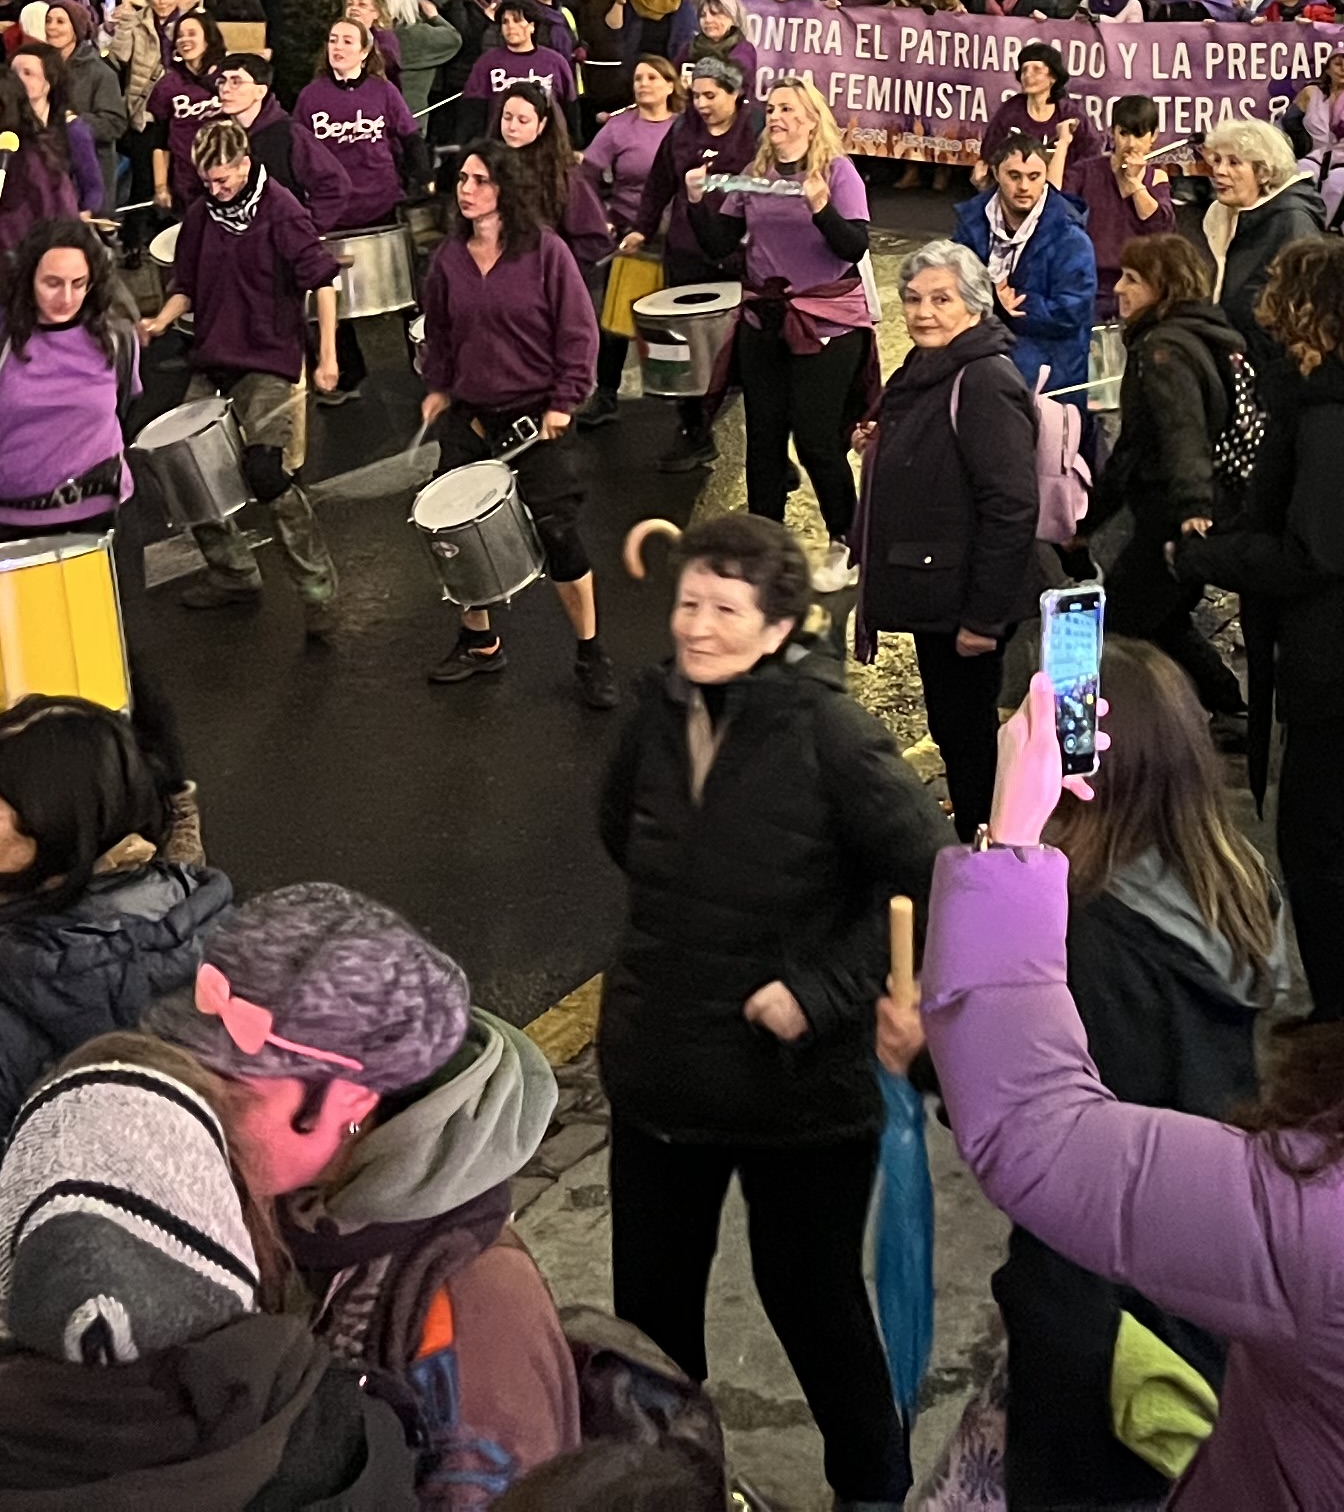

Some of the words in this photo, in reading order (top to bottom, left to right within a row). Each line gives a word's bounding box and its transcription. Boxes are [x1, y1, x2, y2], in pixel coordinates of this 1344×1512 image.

[747, 13, 843, 56] ONTRA
[856, 23, 889, 61] EL
[1117, 41, 1139, 80] Y
[1152, 42, 1193, 80] LA
[311, 109, 386, 140] Bembé
[829, 69, 989, 124] FEMINISTA
[1068, 92, 1258, 134] RTERAS
